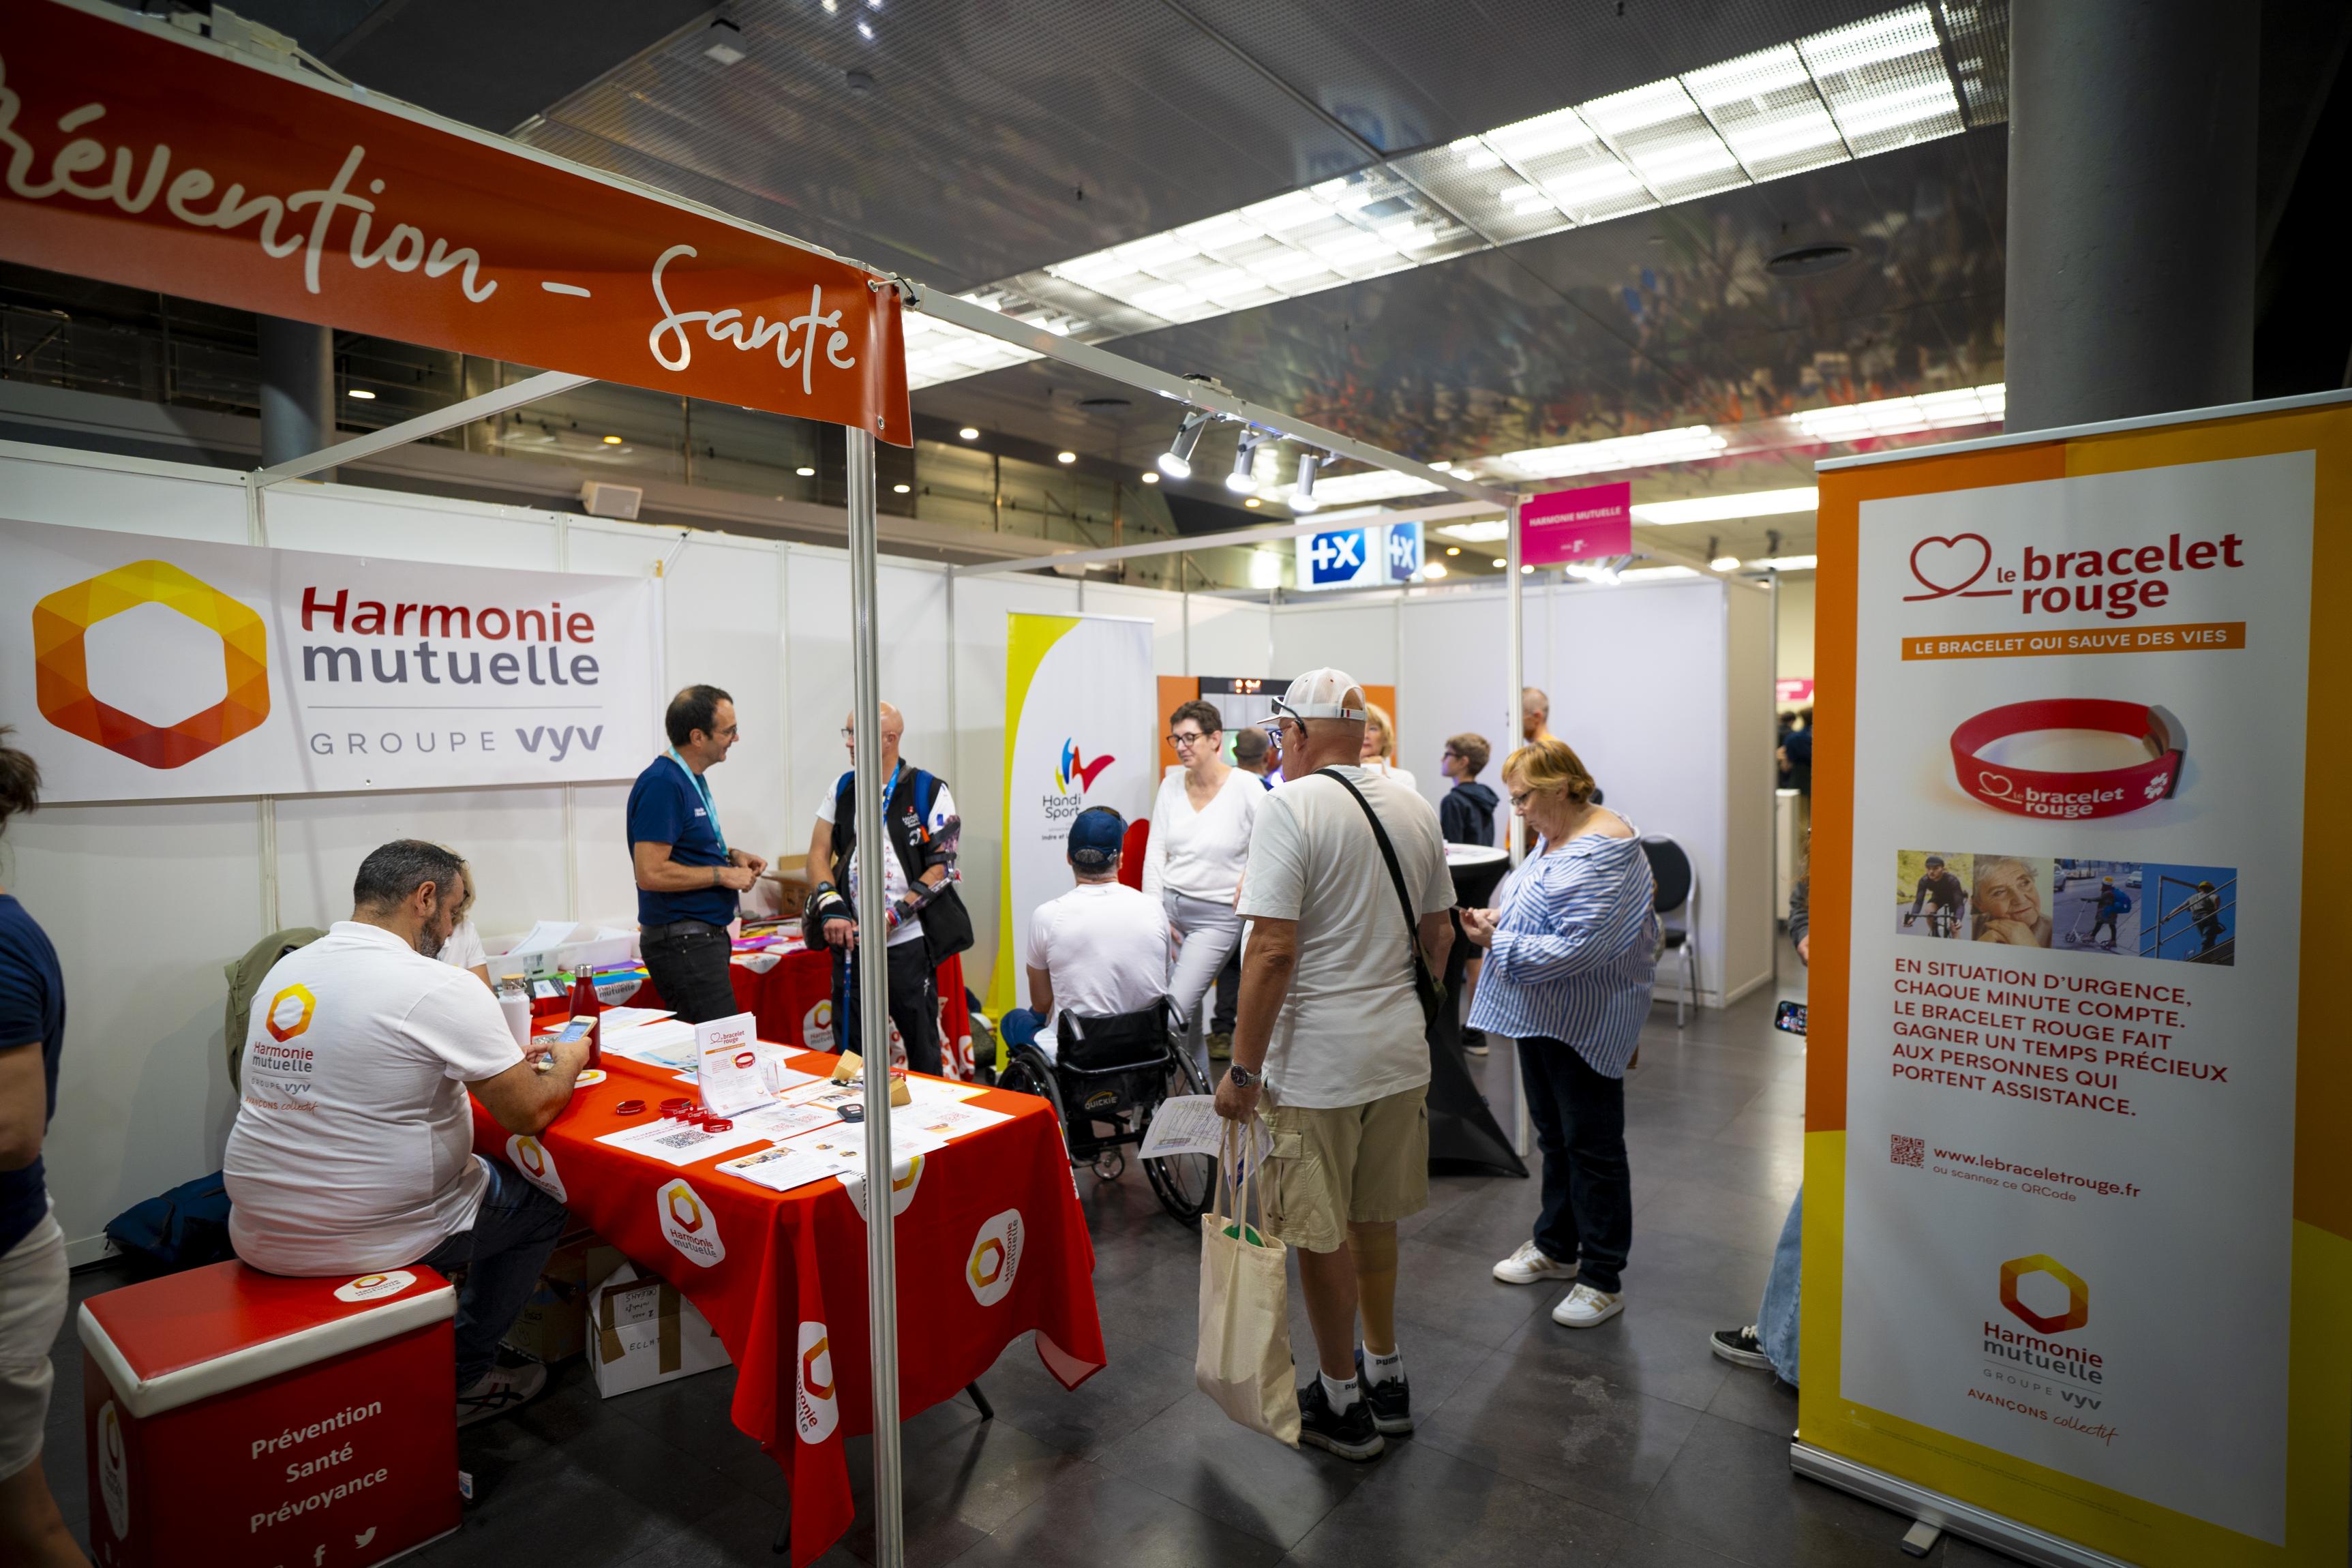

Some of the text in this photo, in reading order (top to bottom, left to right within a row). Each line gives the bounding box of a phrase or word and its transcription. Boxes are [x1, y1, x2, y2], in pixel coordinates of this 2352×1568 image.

[649, 244, 856, 395] Santé
[1529, 506, 1621, 527] HARMONIE MUTUELLE
[1997, 533, 2245, 583] le bracelet
[301, 586, 594, 644] Harmonie
[2022, 579, 2169, 620] rouge
[1915, 629, 2228, 655] LE BRACELET QUI SAUVE DES VIES
[303, 641, 600, 686] mutuelle
[310, 725, 603, 762] GROUPE vyv
[1042, 794, 1081, 807] Handi
[1045, 806, 1079, 821] Sport
[2025, 787, 2124, 804] bracelet
[2025, 802, 2093, 818] rouge
[1895, 958, 1921, 975] EN
[1927, 962, 2036, 987] SITUATION
[1894, 978, 2186, 1028] CHAQUE MINUTE COMPTE.
[1894, 1000, 2173, 1051] LE BRACELET ROUGE FAIT
[252, 1055, 312, 1073] mutuelle
[254, 1041, 314, 1061] Harmonie
[1893, 1021, 2229, 1083] GAGNER UN TEMPS PRÉCIEUX
[1893, 1043, 2117, 1090] AUX PERSONNES QUI
[245, 1096, 278, 1110] AVANÇONS
[1085, 1096, 1119, 1110] QUICKIE
[1893, 1064, 2137, 1117] PORTENT ASSISTANCE.
[1933, 1147, 2141, 1198] www.lebraceletrouge.fr
[1933, 1166, 2077, 1203] ou scannez ce QRCode
[670, 1228, 714, 1250] Harmonie
[674, 1239, 717, 1258] mutuelle
[1983, 1338, 2102, 1385] mutuelle
[1984, 1321, 2103, 1368] Harmonie
[1983, 1369, 2102, 1411] GROUPE vyv
[251, 1401, 382, 1460] Prévention
[1968, 1389, 2120, 1447] AVANÇONS collectif
[286, 1442, 353, 1483] Santé
[250, 1466, 388, 1534] Prévoyance
